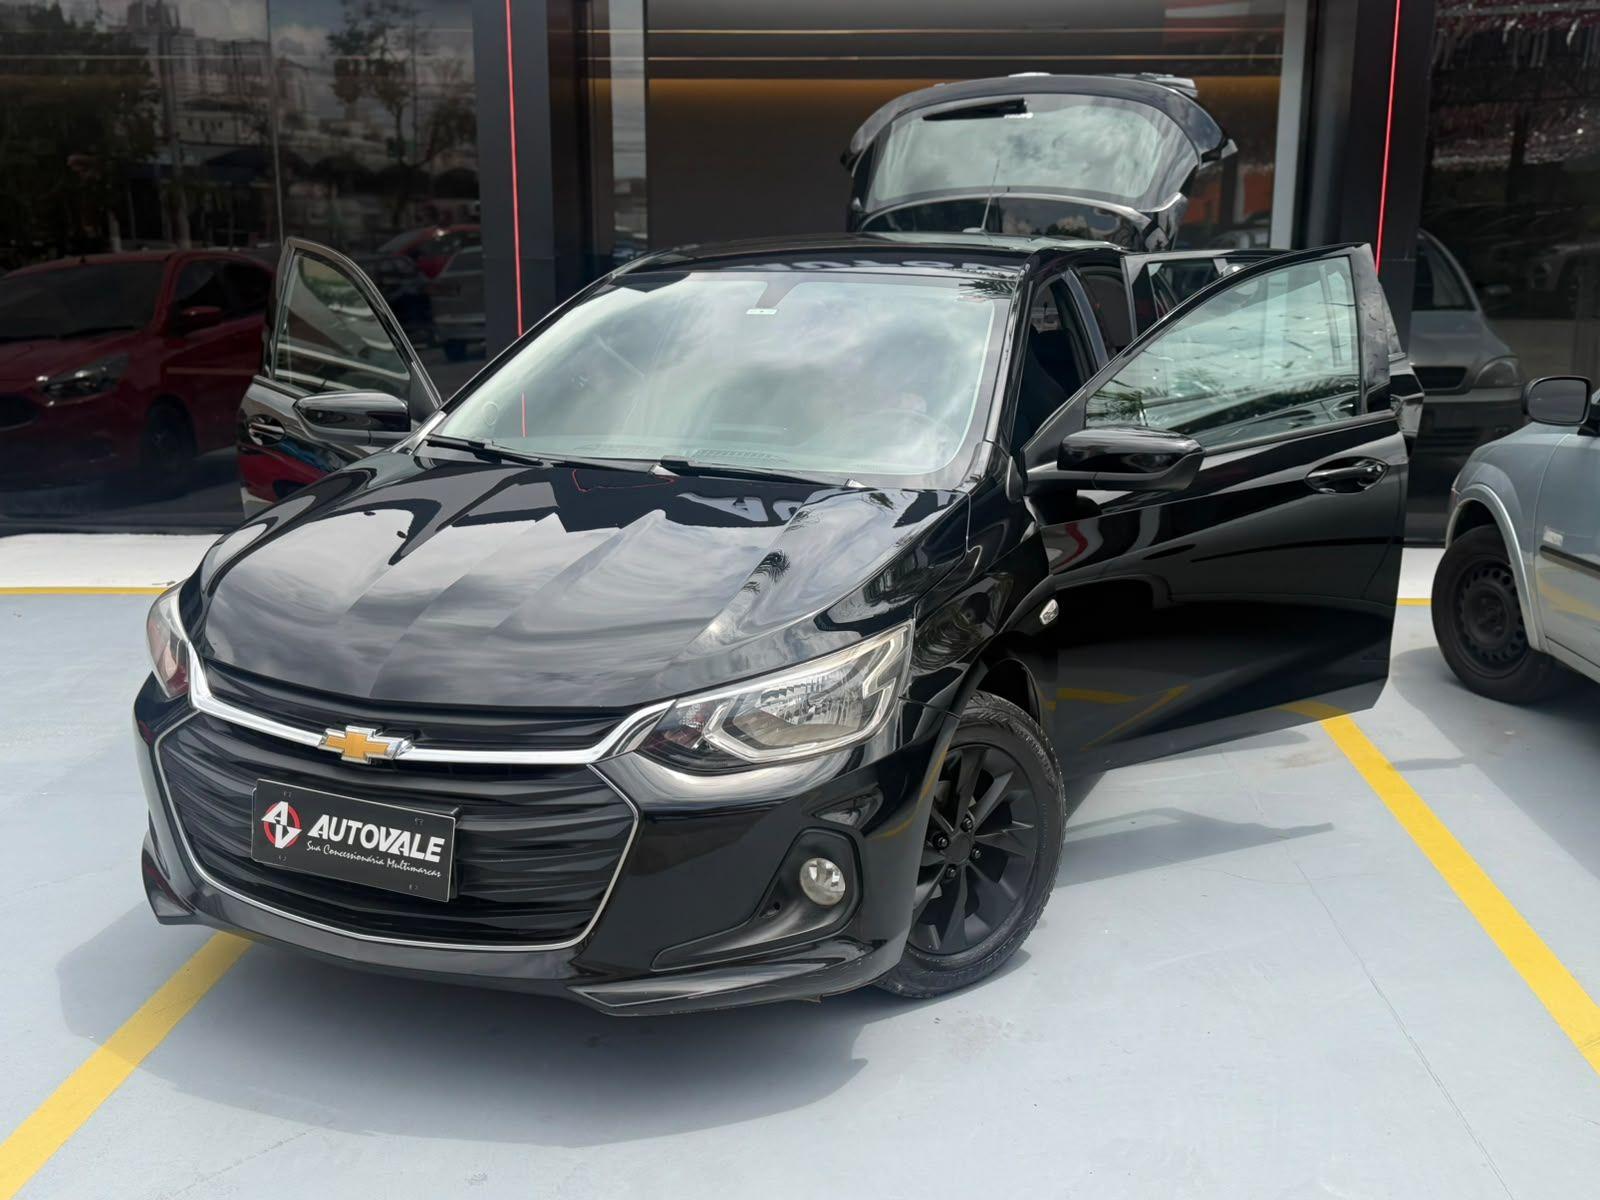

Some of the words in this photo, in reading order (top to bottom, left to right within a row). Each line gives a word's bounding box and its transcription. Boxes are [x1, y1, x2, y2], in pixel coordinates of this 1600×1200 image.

[306, 840, 320, 852] Sua
[387, 858, 442, 878] Multimarcas
[307, 814, 445, 862] AUTOVALE
